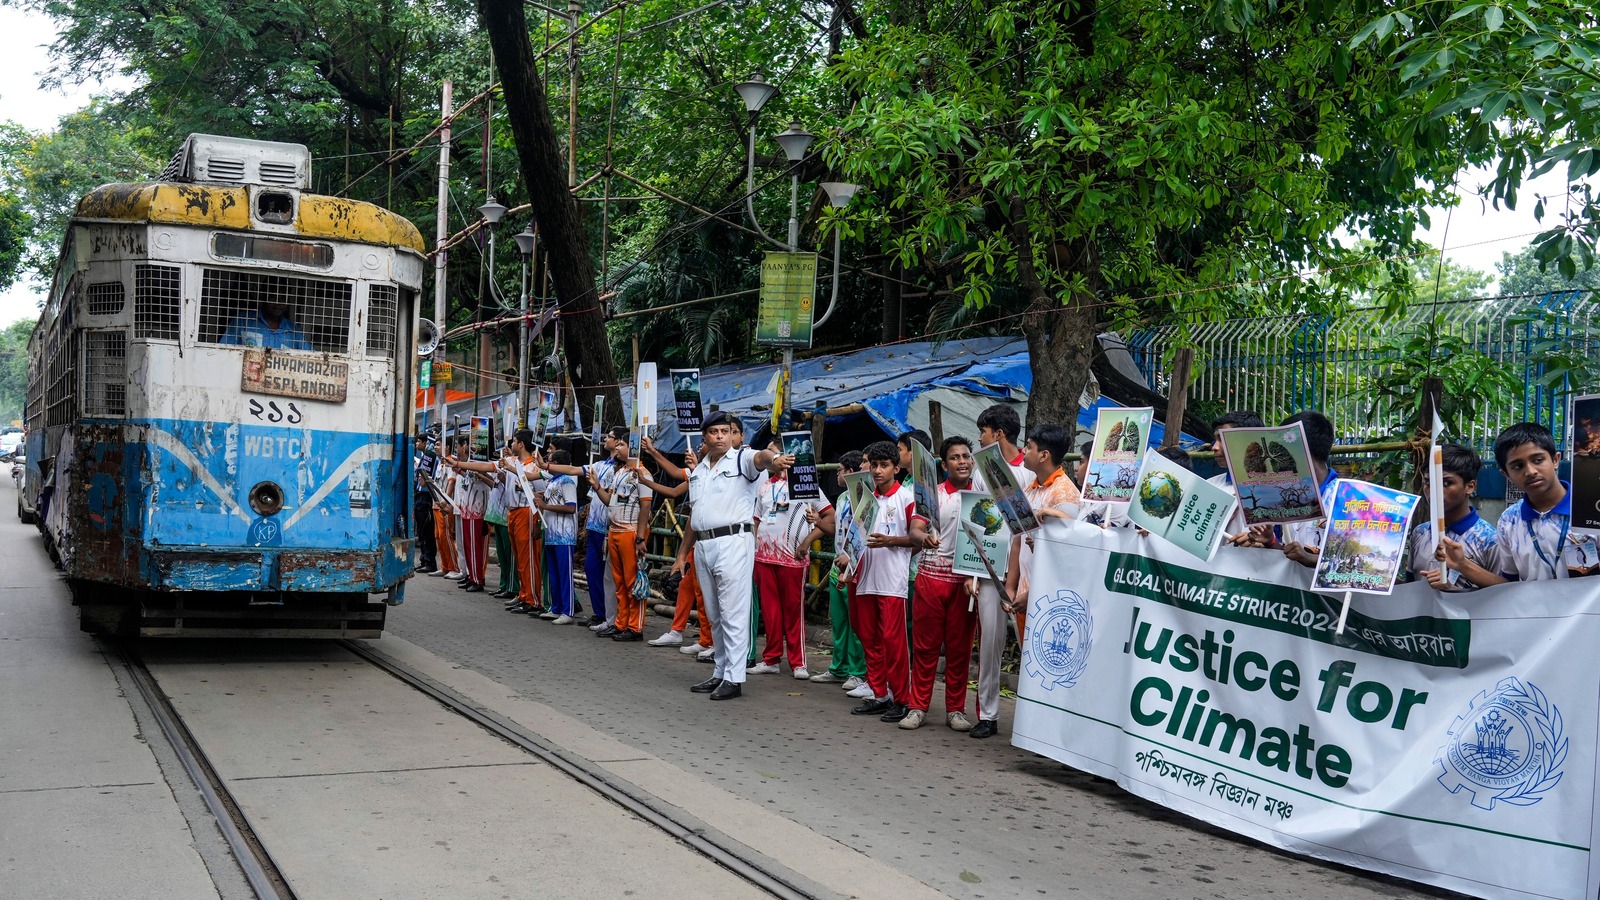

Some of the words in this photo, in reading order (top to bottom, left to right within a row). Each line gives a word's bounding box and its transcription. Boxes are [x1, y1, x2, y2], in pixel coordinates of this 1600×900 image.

[266, 356, 346, 377] SHYAMBAZAR
[264, 376, 343, 396] ESPLANADE
[244, 435, 300, 459] WBTC
[1177, 494, 1198, 531] Justice
[1190, 509, 1202, 525] for
[1195, 503, 1217, 541] Climate
[258, 525, 275, 540] KP
[1114, 568, 1161, 592] GLOBAL
[1164, 579, 1227, 608] CLIMATE
[1228, 595, 1289, 622] STRIKE
[1317, 660, 1429, 730] for
[1130, 676, 1352, 788] Climate
[1135, 750, 1208, 792] পশ্চিমবঙ্গ
[1209, 772, 1260, 810] বিজ্ঞান
[1264, 796, 1293, 821] মঞ্চ
[1467, 770, 1491, 784] BANGA
[1492, 776, 1520, 785] VIGYAN
[1521, 754, 1541, 779] MANCHA
